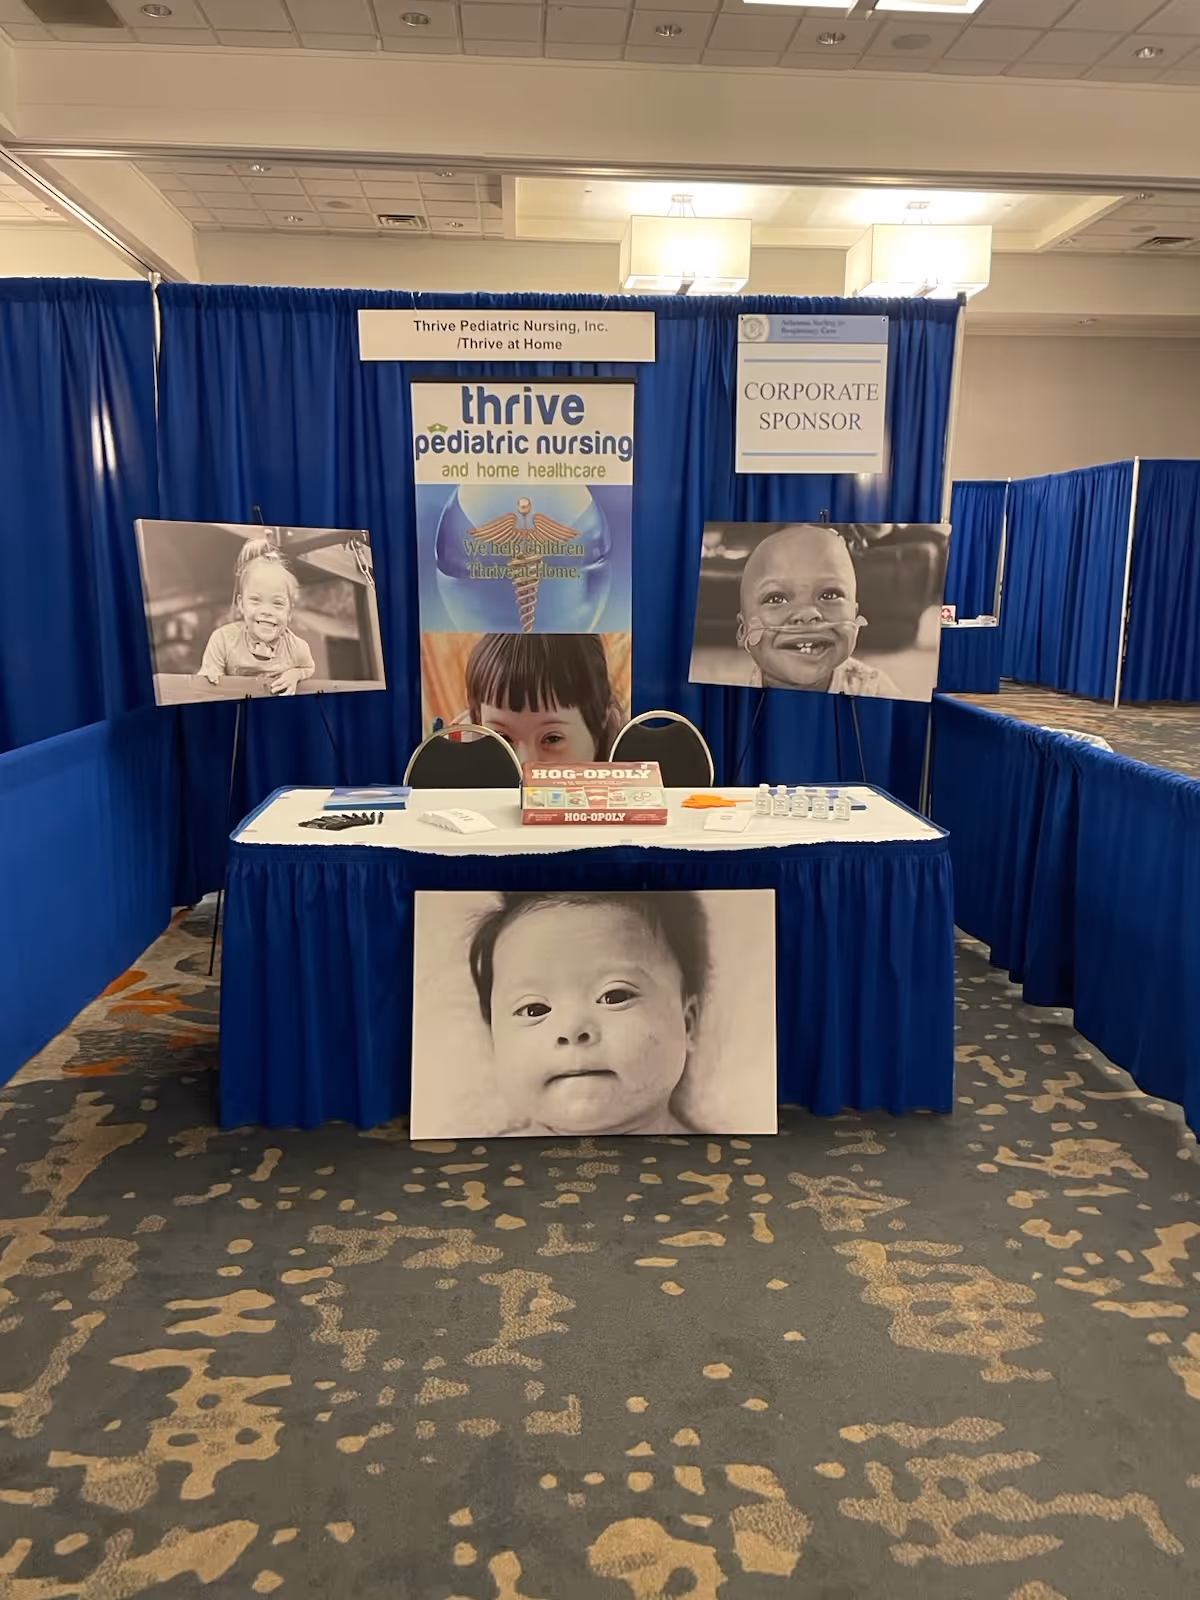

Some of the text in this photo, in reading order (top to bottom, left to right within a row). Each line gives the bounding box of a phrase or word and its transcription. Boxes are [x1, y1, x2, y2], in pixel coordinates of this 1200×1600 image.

[413, 320, 609, 334] Thrive Pediatric Nursing, Inc.
[457, 337, 563, 350] /Thrive at Home
[744, 382, 879, 401] CORPORATE
[461, 386, 585, 426] thrive
[759, 412, 862, 430] SPONSOR
[415, 430, 633, 462] pediatric nursing
[442, 462, 607, 478] and home healthcare
[464, 539, 585, 559] We help children
[468, 562, 511, 578] Thrive
[531, 769, 652, 779] HOG-OPOLY
[564, 812, 626, 822] HOG-OPOLY
